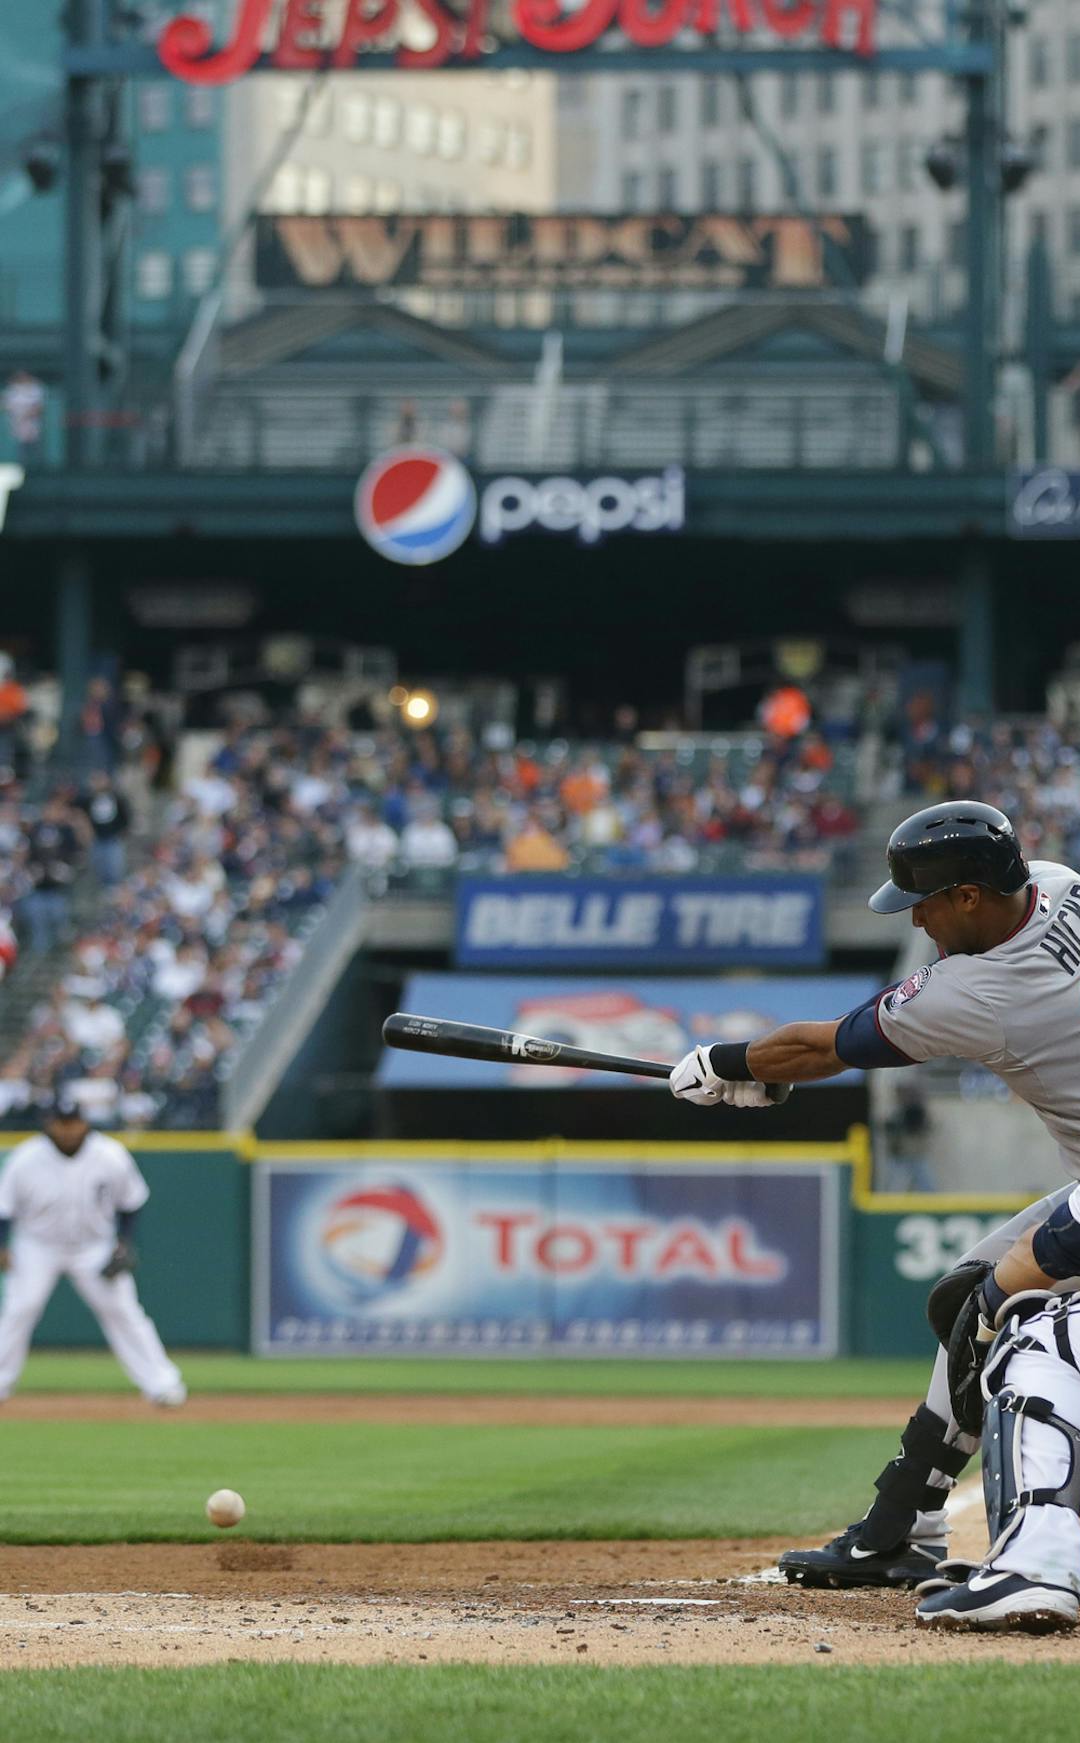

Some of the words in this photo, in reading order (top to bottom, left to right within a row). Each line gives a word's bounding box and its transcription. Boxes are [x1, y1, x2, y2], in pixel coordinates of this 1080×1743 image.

[276, 213, 851, 288] WILDCAT
[479, 464, 686, 544] pepsi
[465, 893, 664, 949] BELLE
[672, 893, 813, 949] TIRE
[474, 1210, 786, 1276] TOTAL
